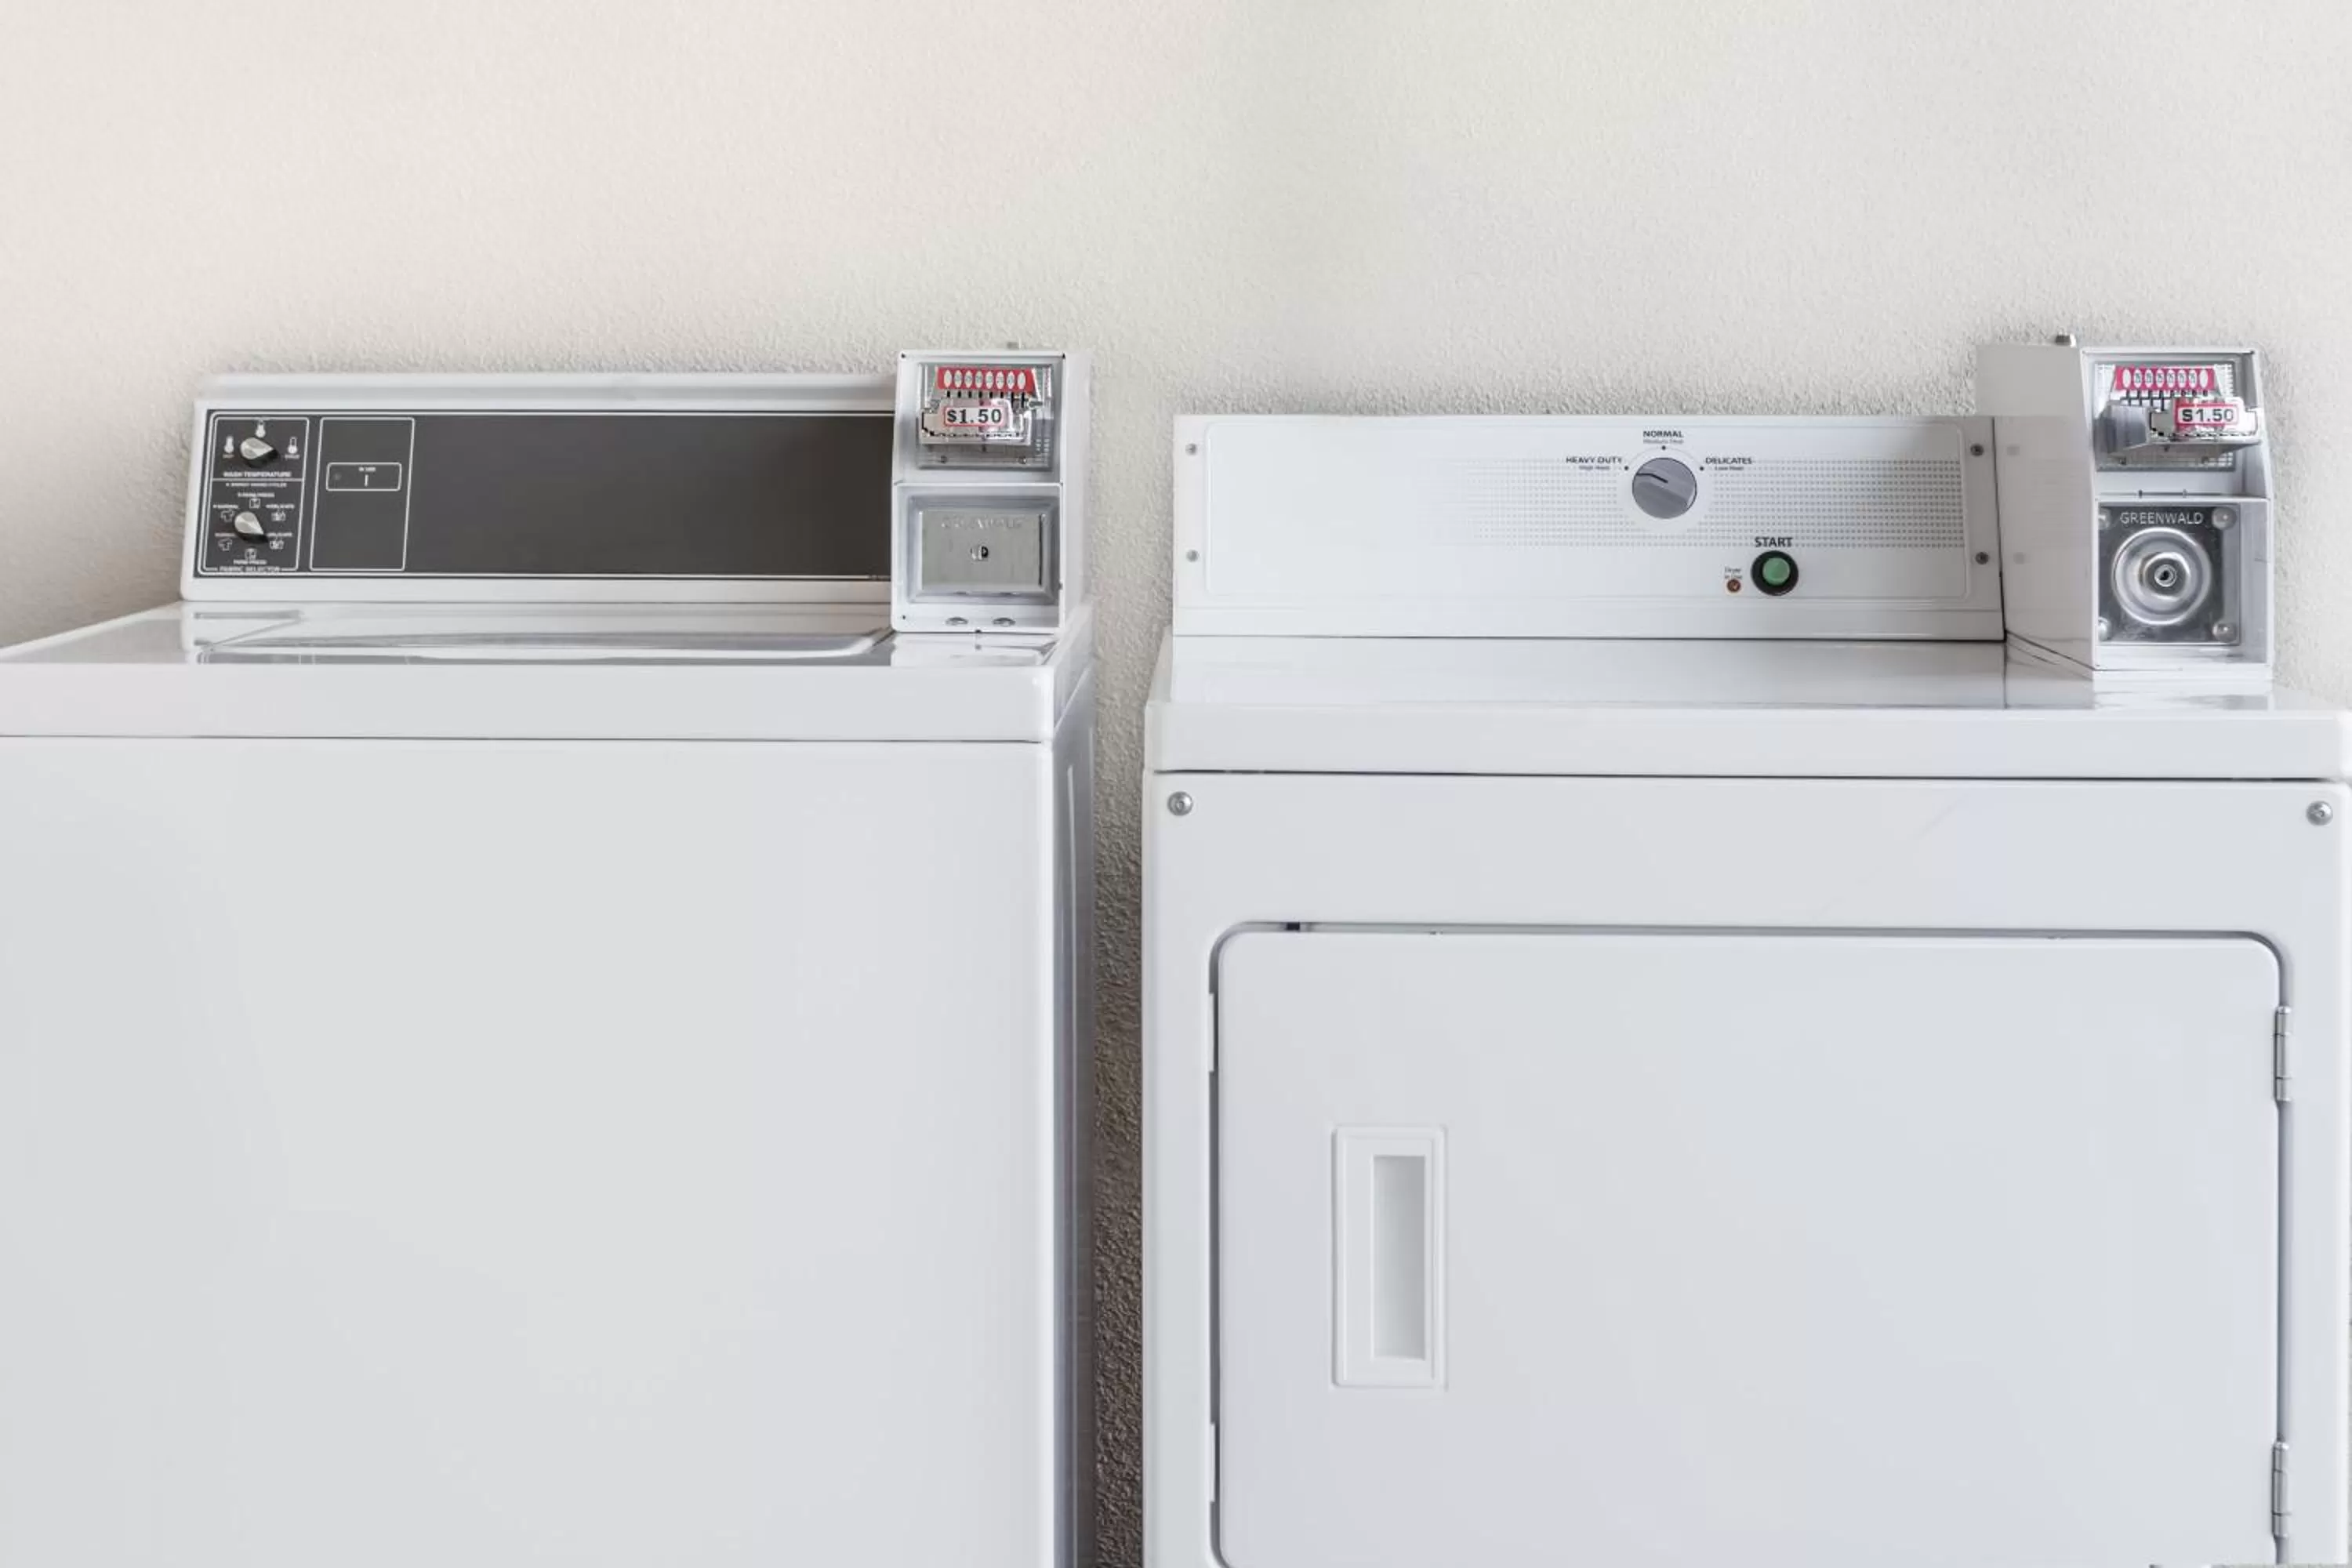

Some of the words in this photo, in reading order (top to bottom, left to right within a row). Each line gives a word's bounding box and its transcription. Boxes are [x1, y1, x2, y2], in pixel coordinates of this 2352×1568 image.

[946, 408, 1002, 423] $1.50
[2119, 512, 2204, 524] GREENWALD
[1755, 536, 1793, 547] START
